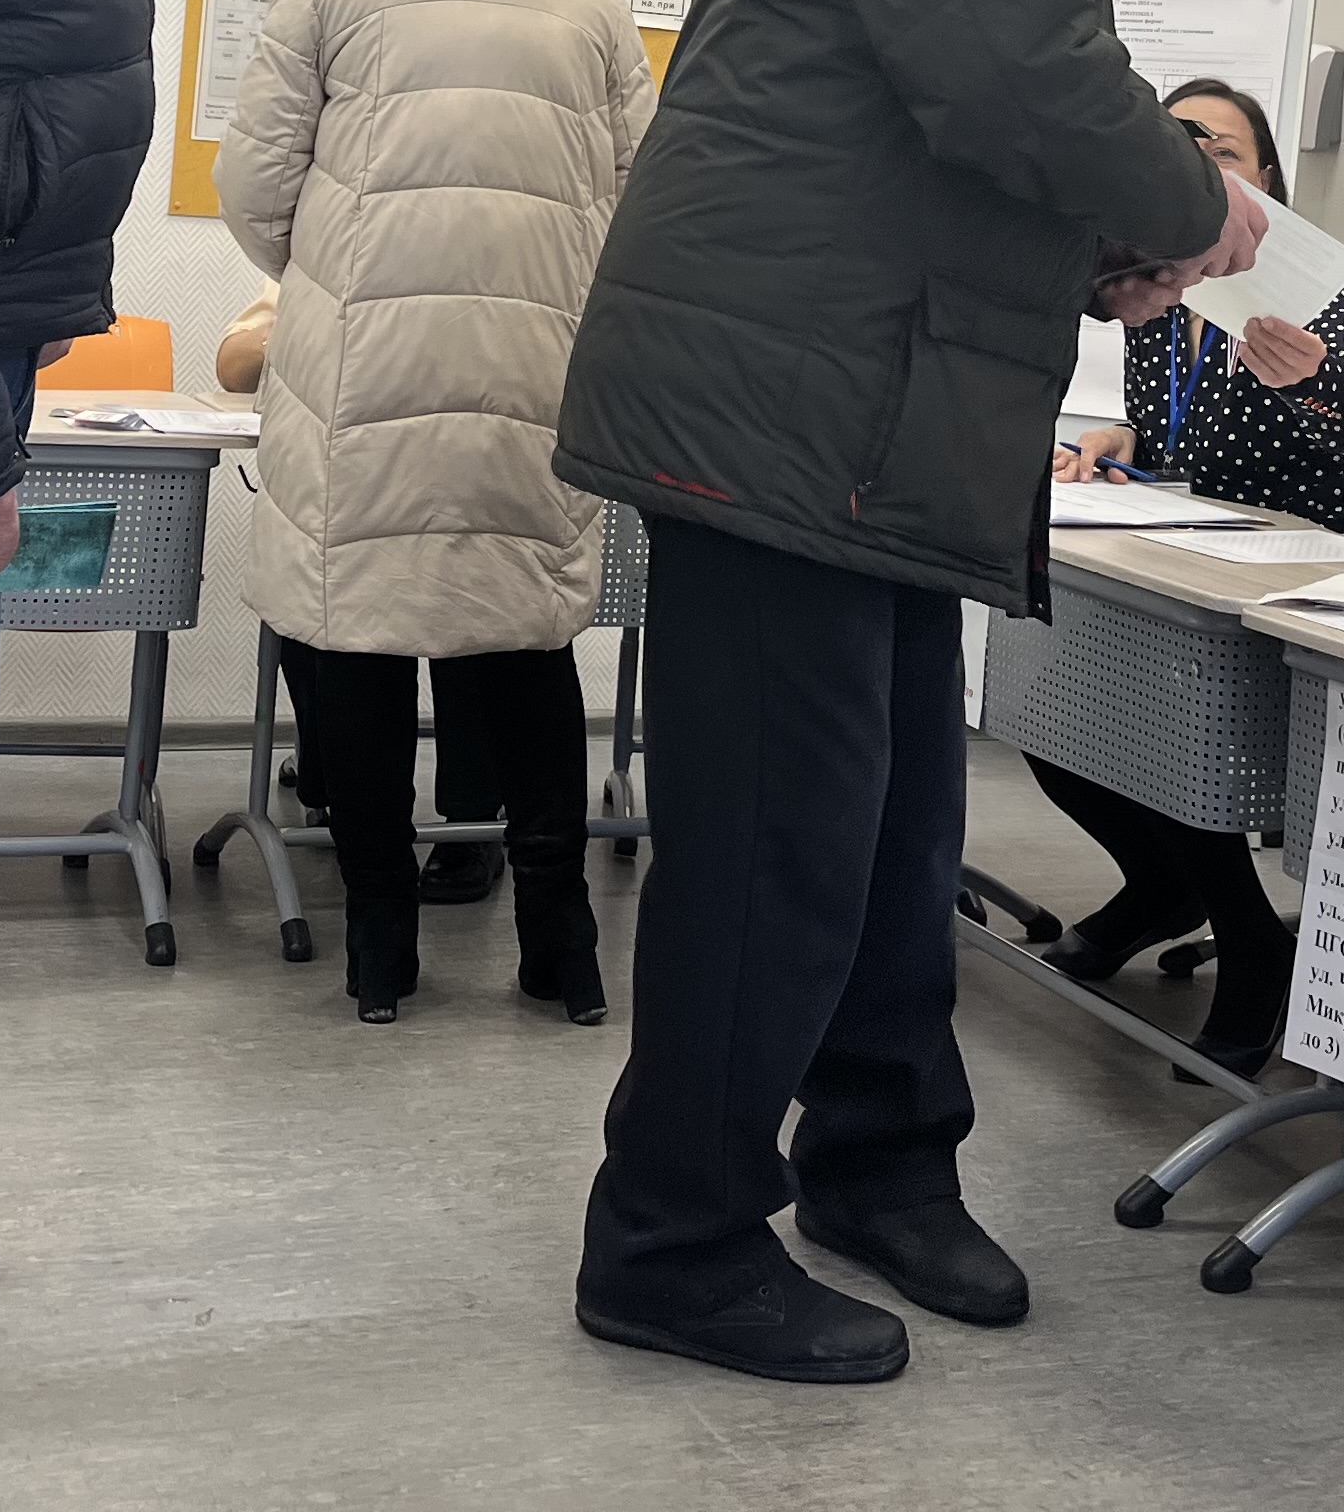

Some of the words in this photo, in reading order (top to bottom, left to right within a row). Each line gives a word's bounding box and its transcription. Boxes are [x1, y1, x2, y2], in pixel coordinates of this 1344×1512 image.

[657, 2, 674, 10] при
[1321, 868, 1344, 889] ул.
[1309, 965, 1333, 987] ул.
[1300, 1031, 1320, 1050] до
[1325, 1036, 1340, 1061] 3)
